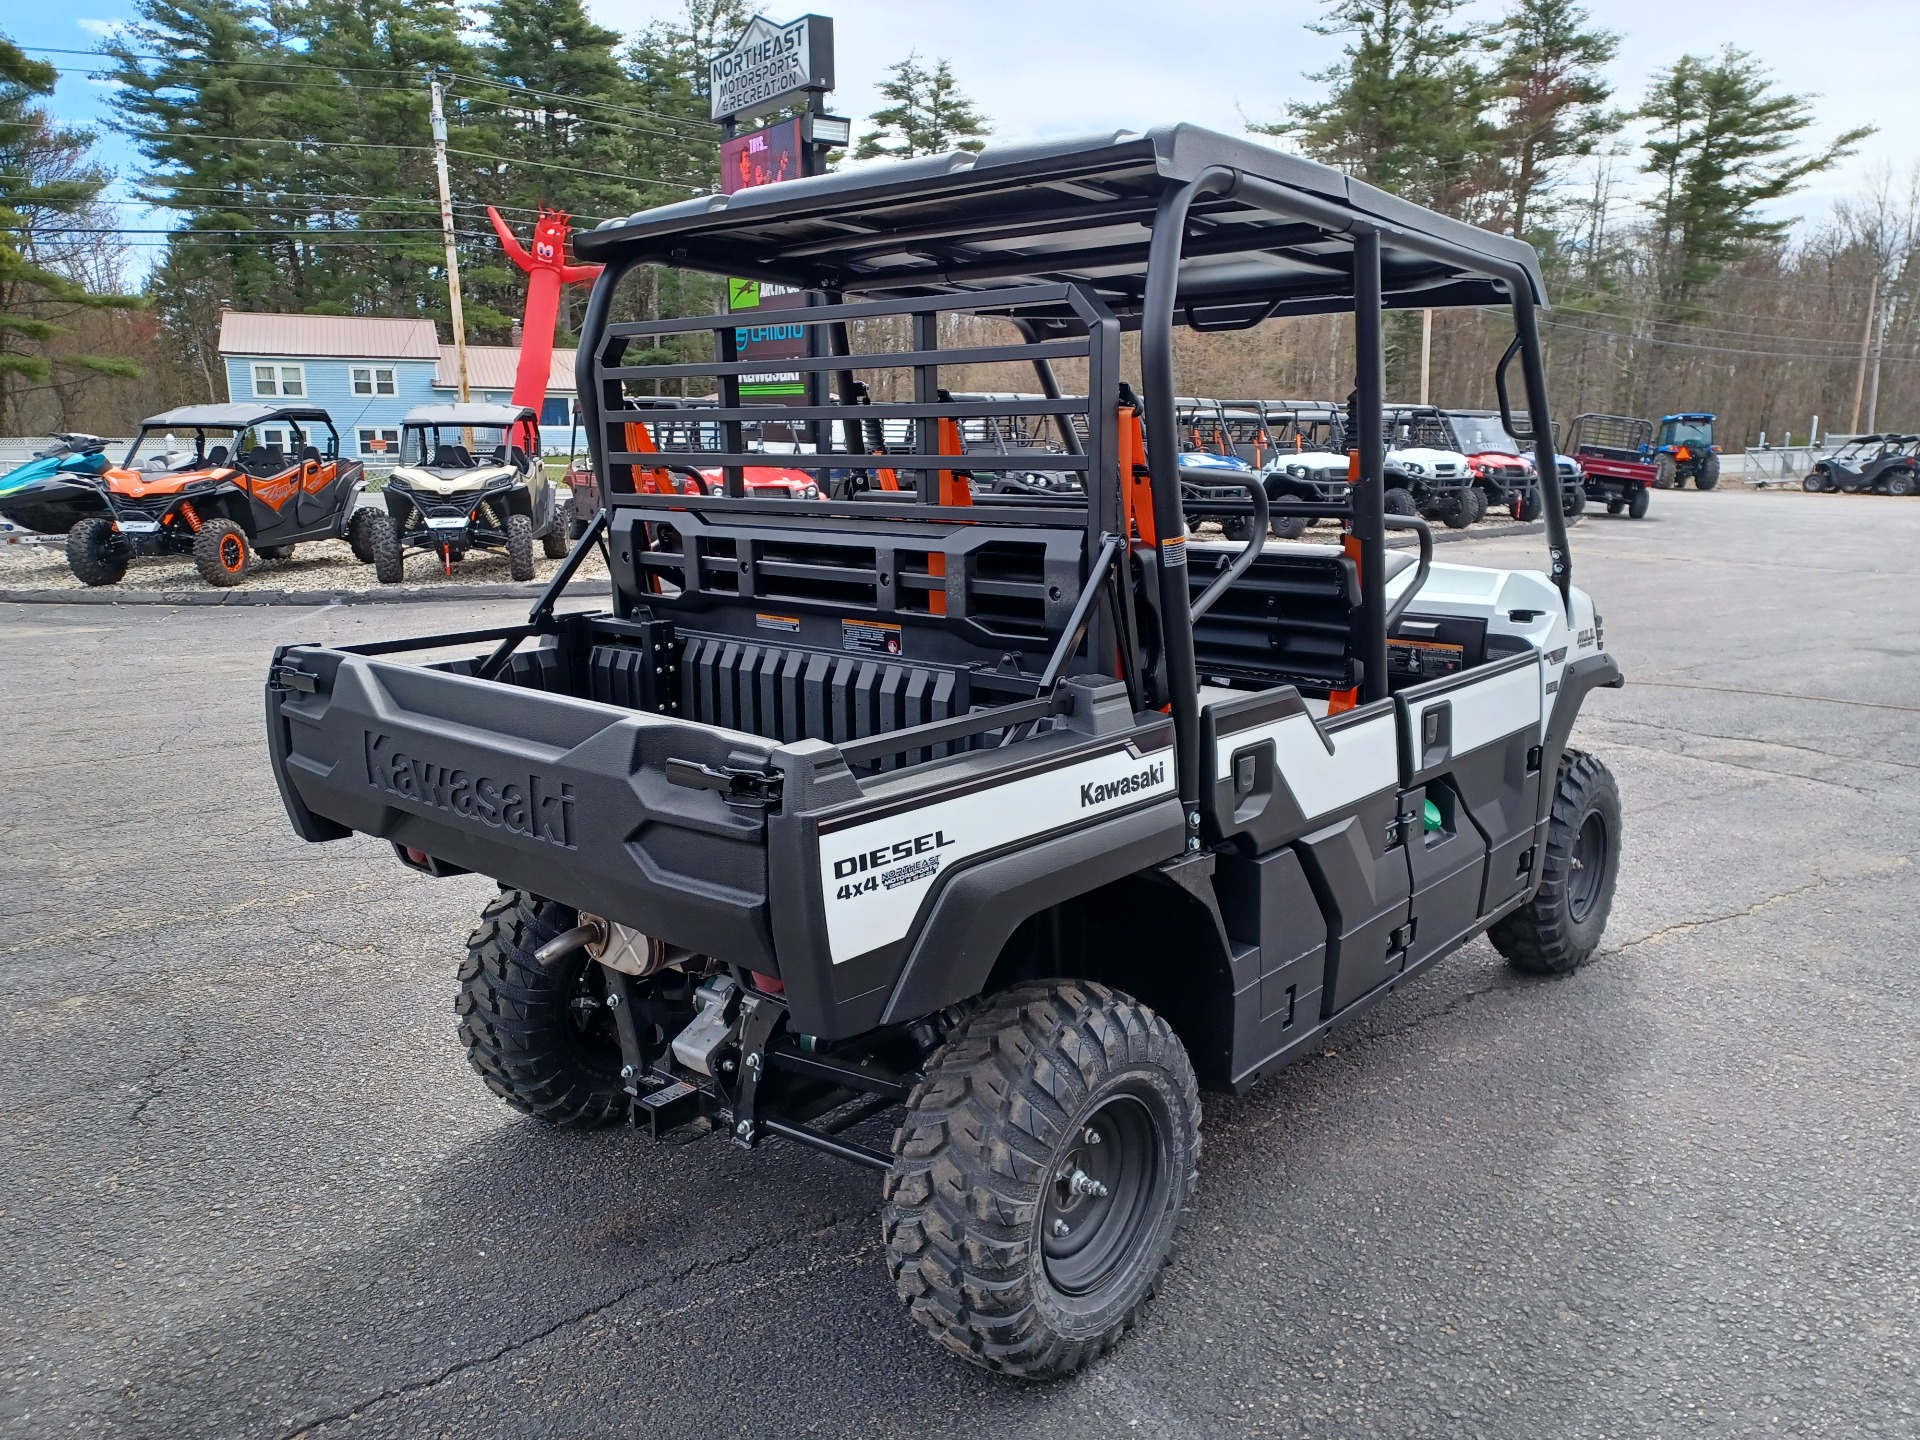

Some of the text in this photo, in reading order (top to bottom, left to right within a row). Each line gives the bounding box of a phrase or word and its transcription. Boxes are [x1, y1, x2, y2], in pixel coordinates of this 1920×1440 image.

[713, 24, 805, 83] NORTHEAST
[720, 52, 799, 98] MOTORSPORTS
[364, 730, 578, 852] Kawasaki
[1080, 761, 1165, 808] Kawasaki
[833, 830, 956, 880] DIESEL
[881, 854, 941, 881] NORTHEAST
[836, 875, 880, 901] 4x4
